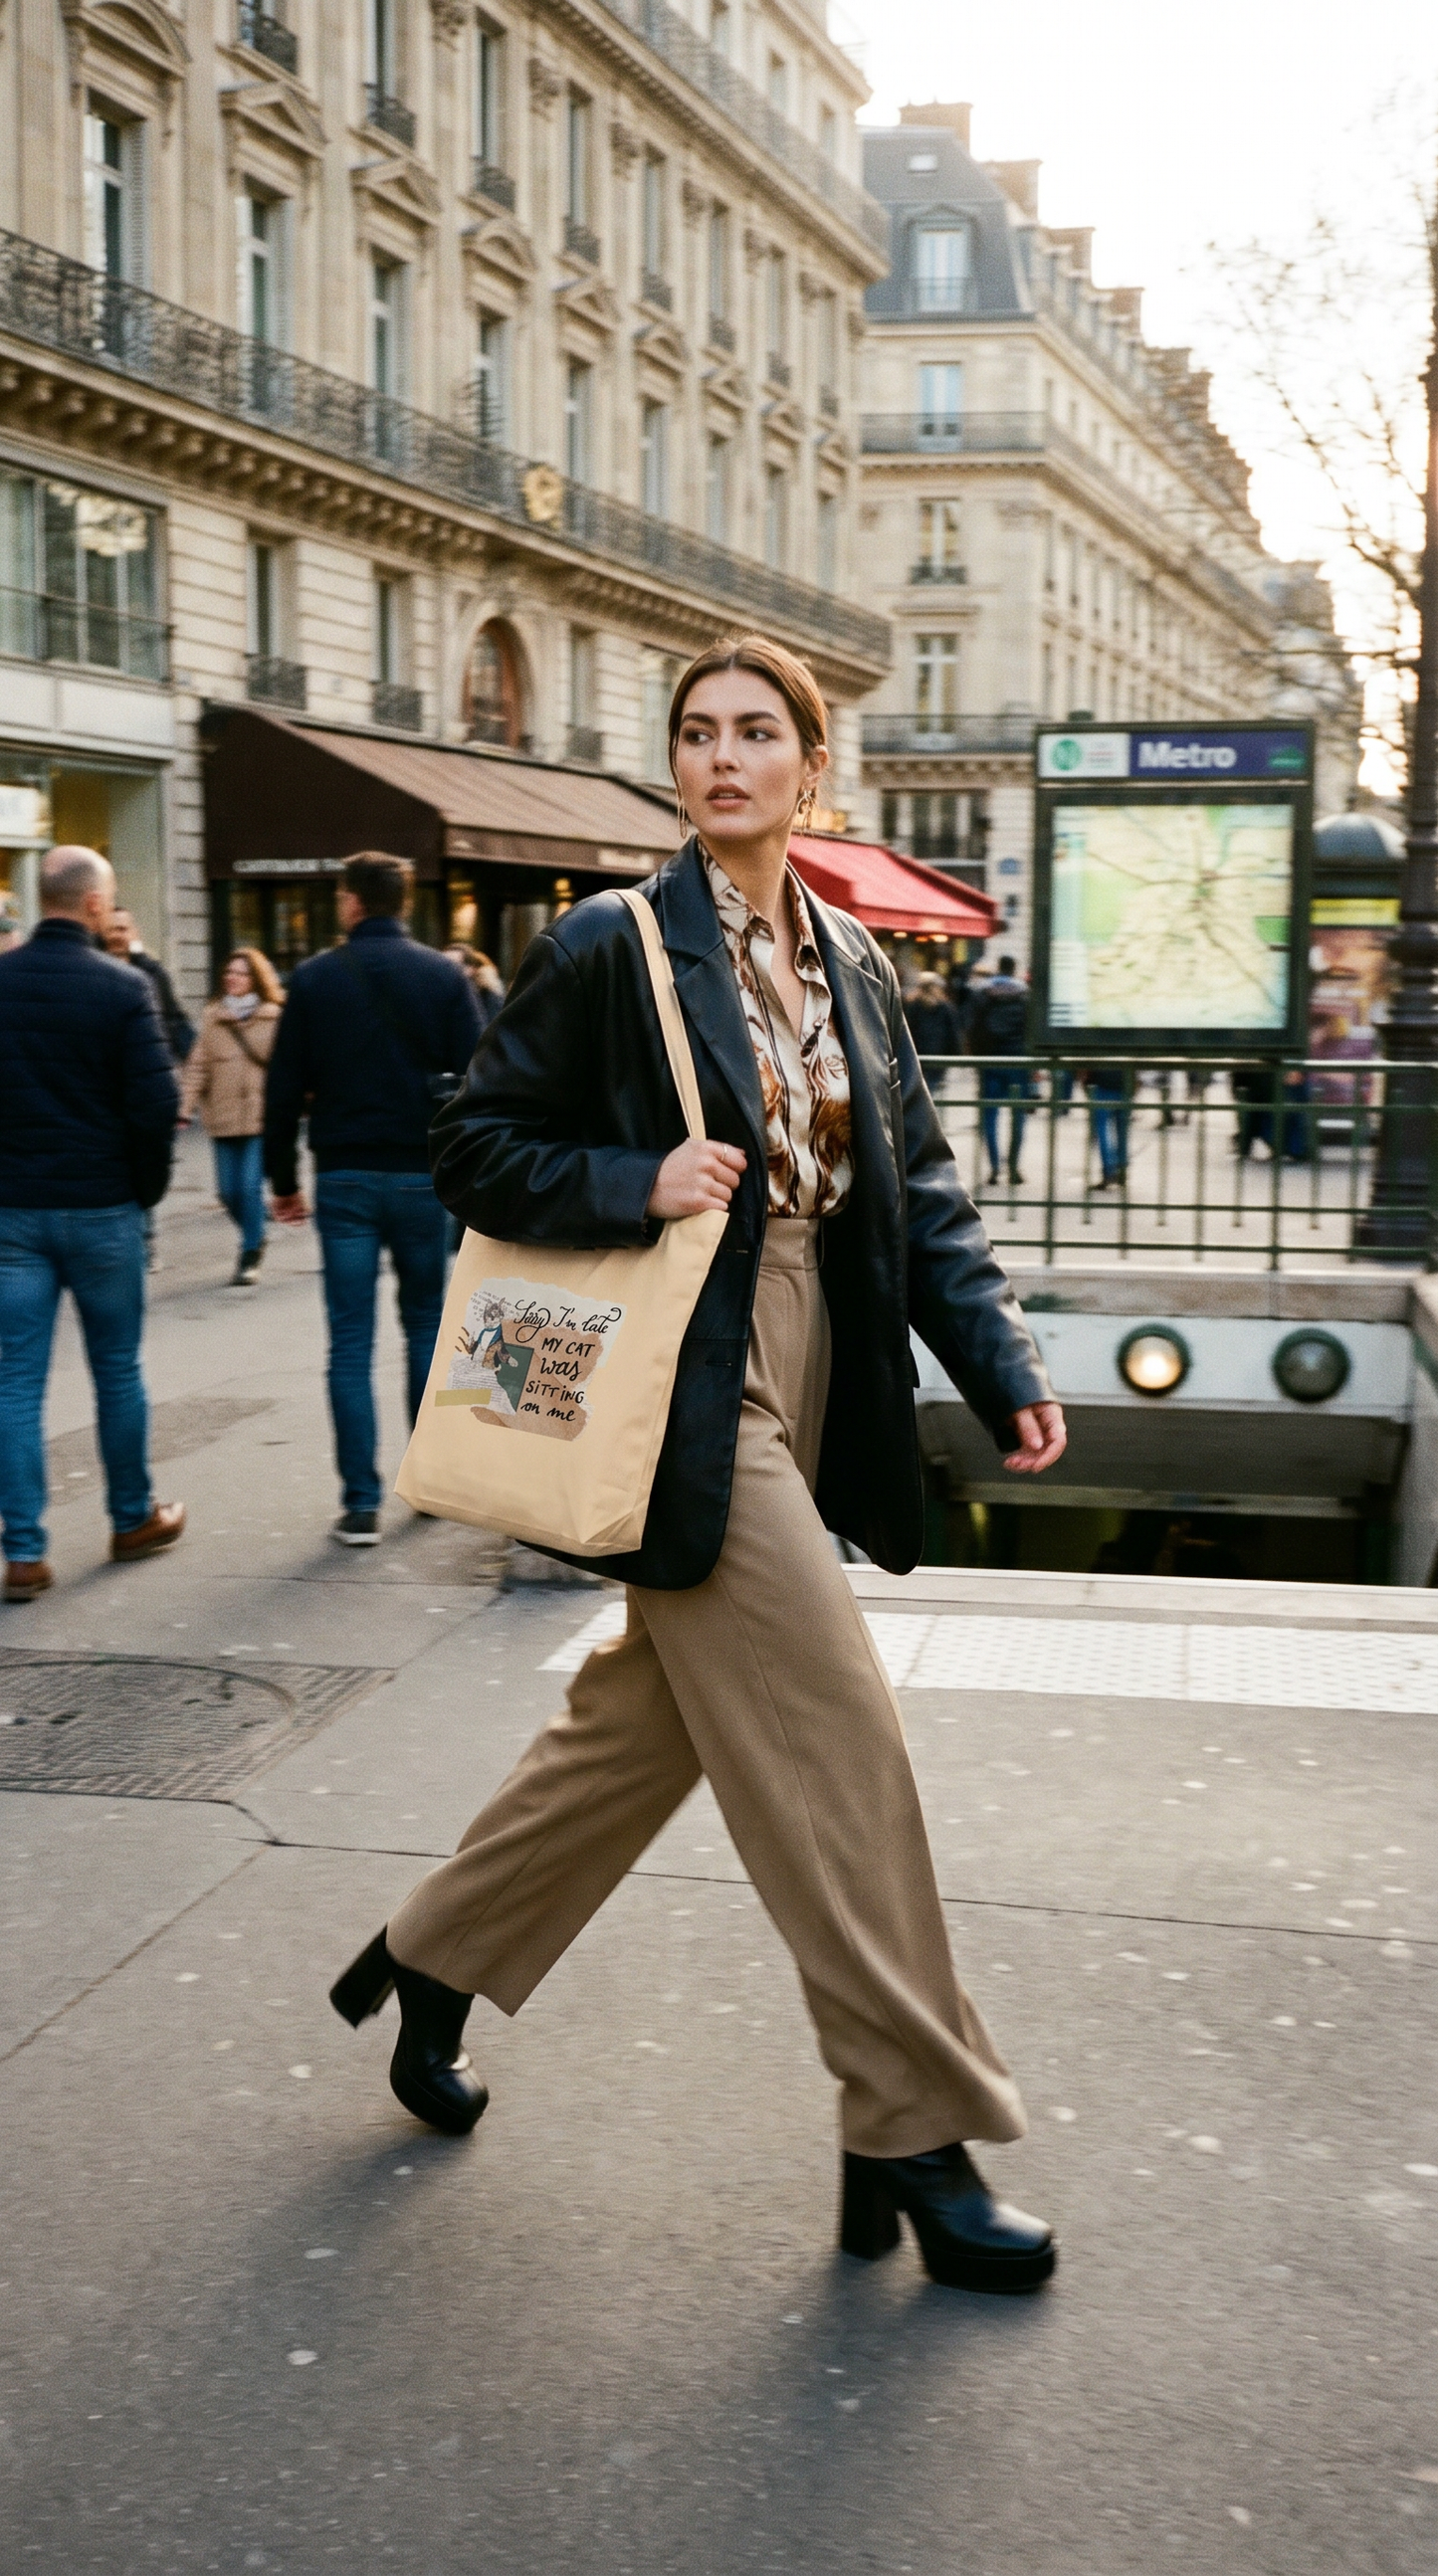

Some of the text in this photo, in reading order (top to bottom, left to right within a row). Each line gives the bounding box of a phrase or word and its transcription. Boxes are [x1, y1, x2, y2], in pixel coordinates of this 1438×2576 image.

[1138, 741, 1237, 768] Metro
[514, 1299, 551, 1343] Sorry
[553, 1305, 576, 1330] I'm
[581, 1307, 622, 1333] late
[541, 1337, 595, 1357] MY CAT
[520, 1402, 576, 1422] on me
